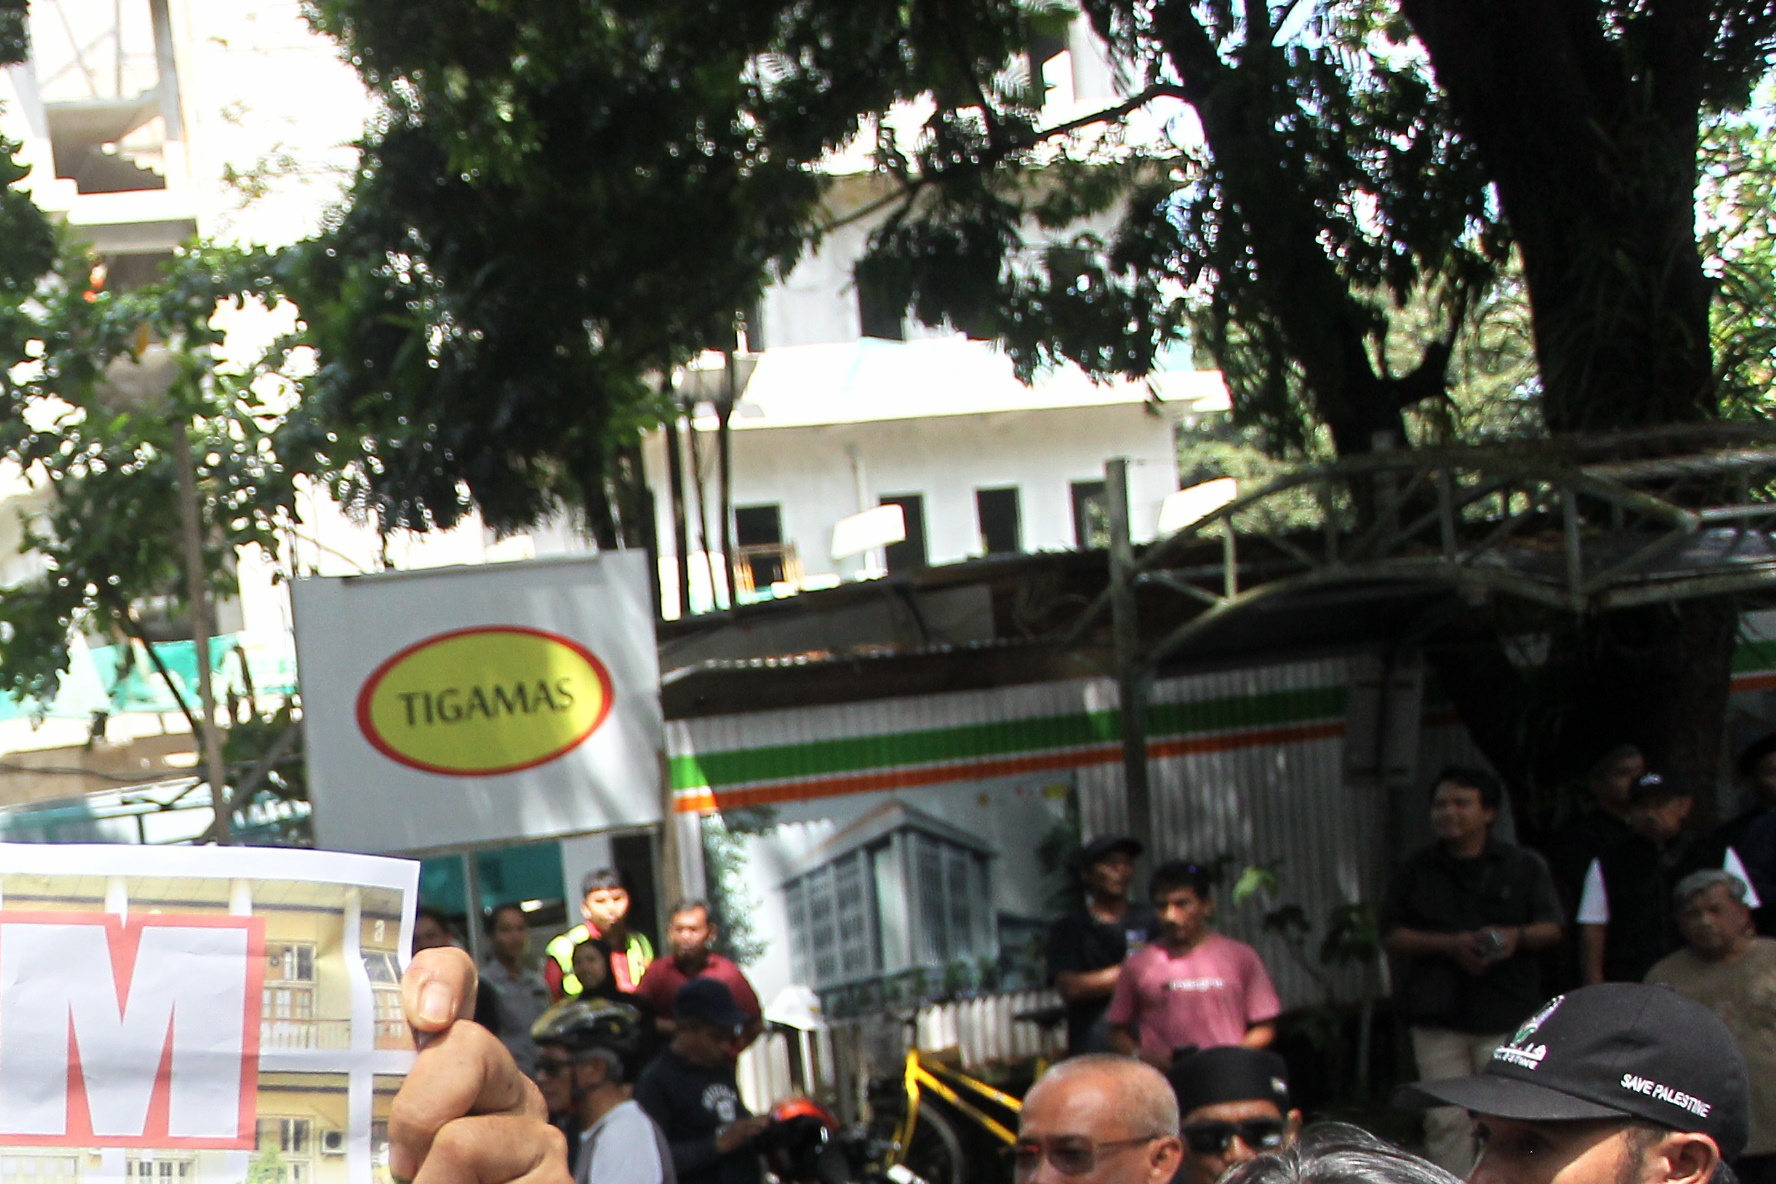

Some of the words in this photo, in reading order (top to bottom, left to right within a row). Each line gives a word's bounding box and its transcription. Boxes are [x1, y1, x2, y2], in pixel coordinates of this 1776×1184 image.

[398, 677, 574, 726] TIGAMAS
[1620, 1073, 1655, 1097] SAVE
[1651, 1084, 1712, 1118] PALESTINE
